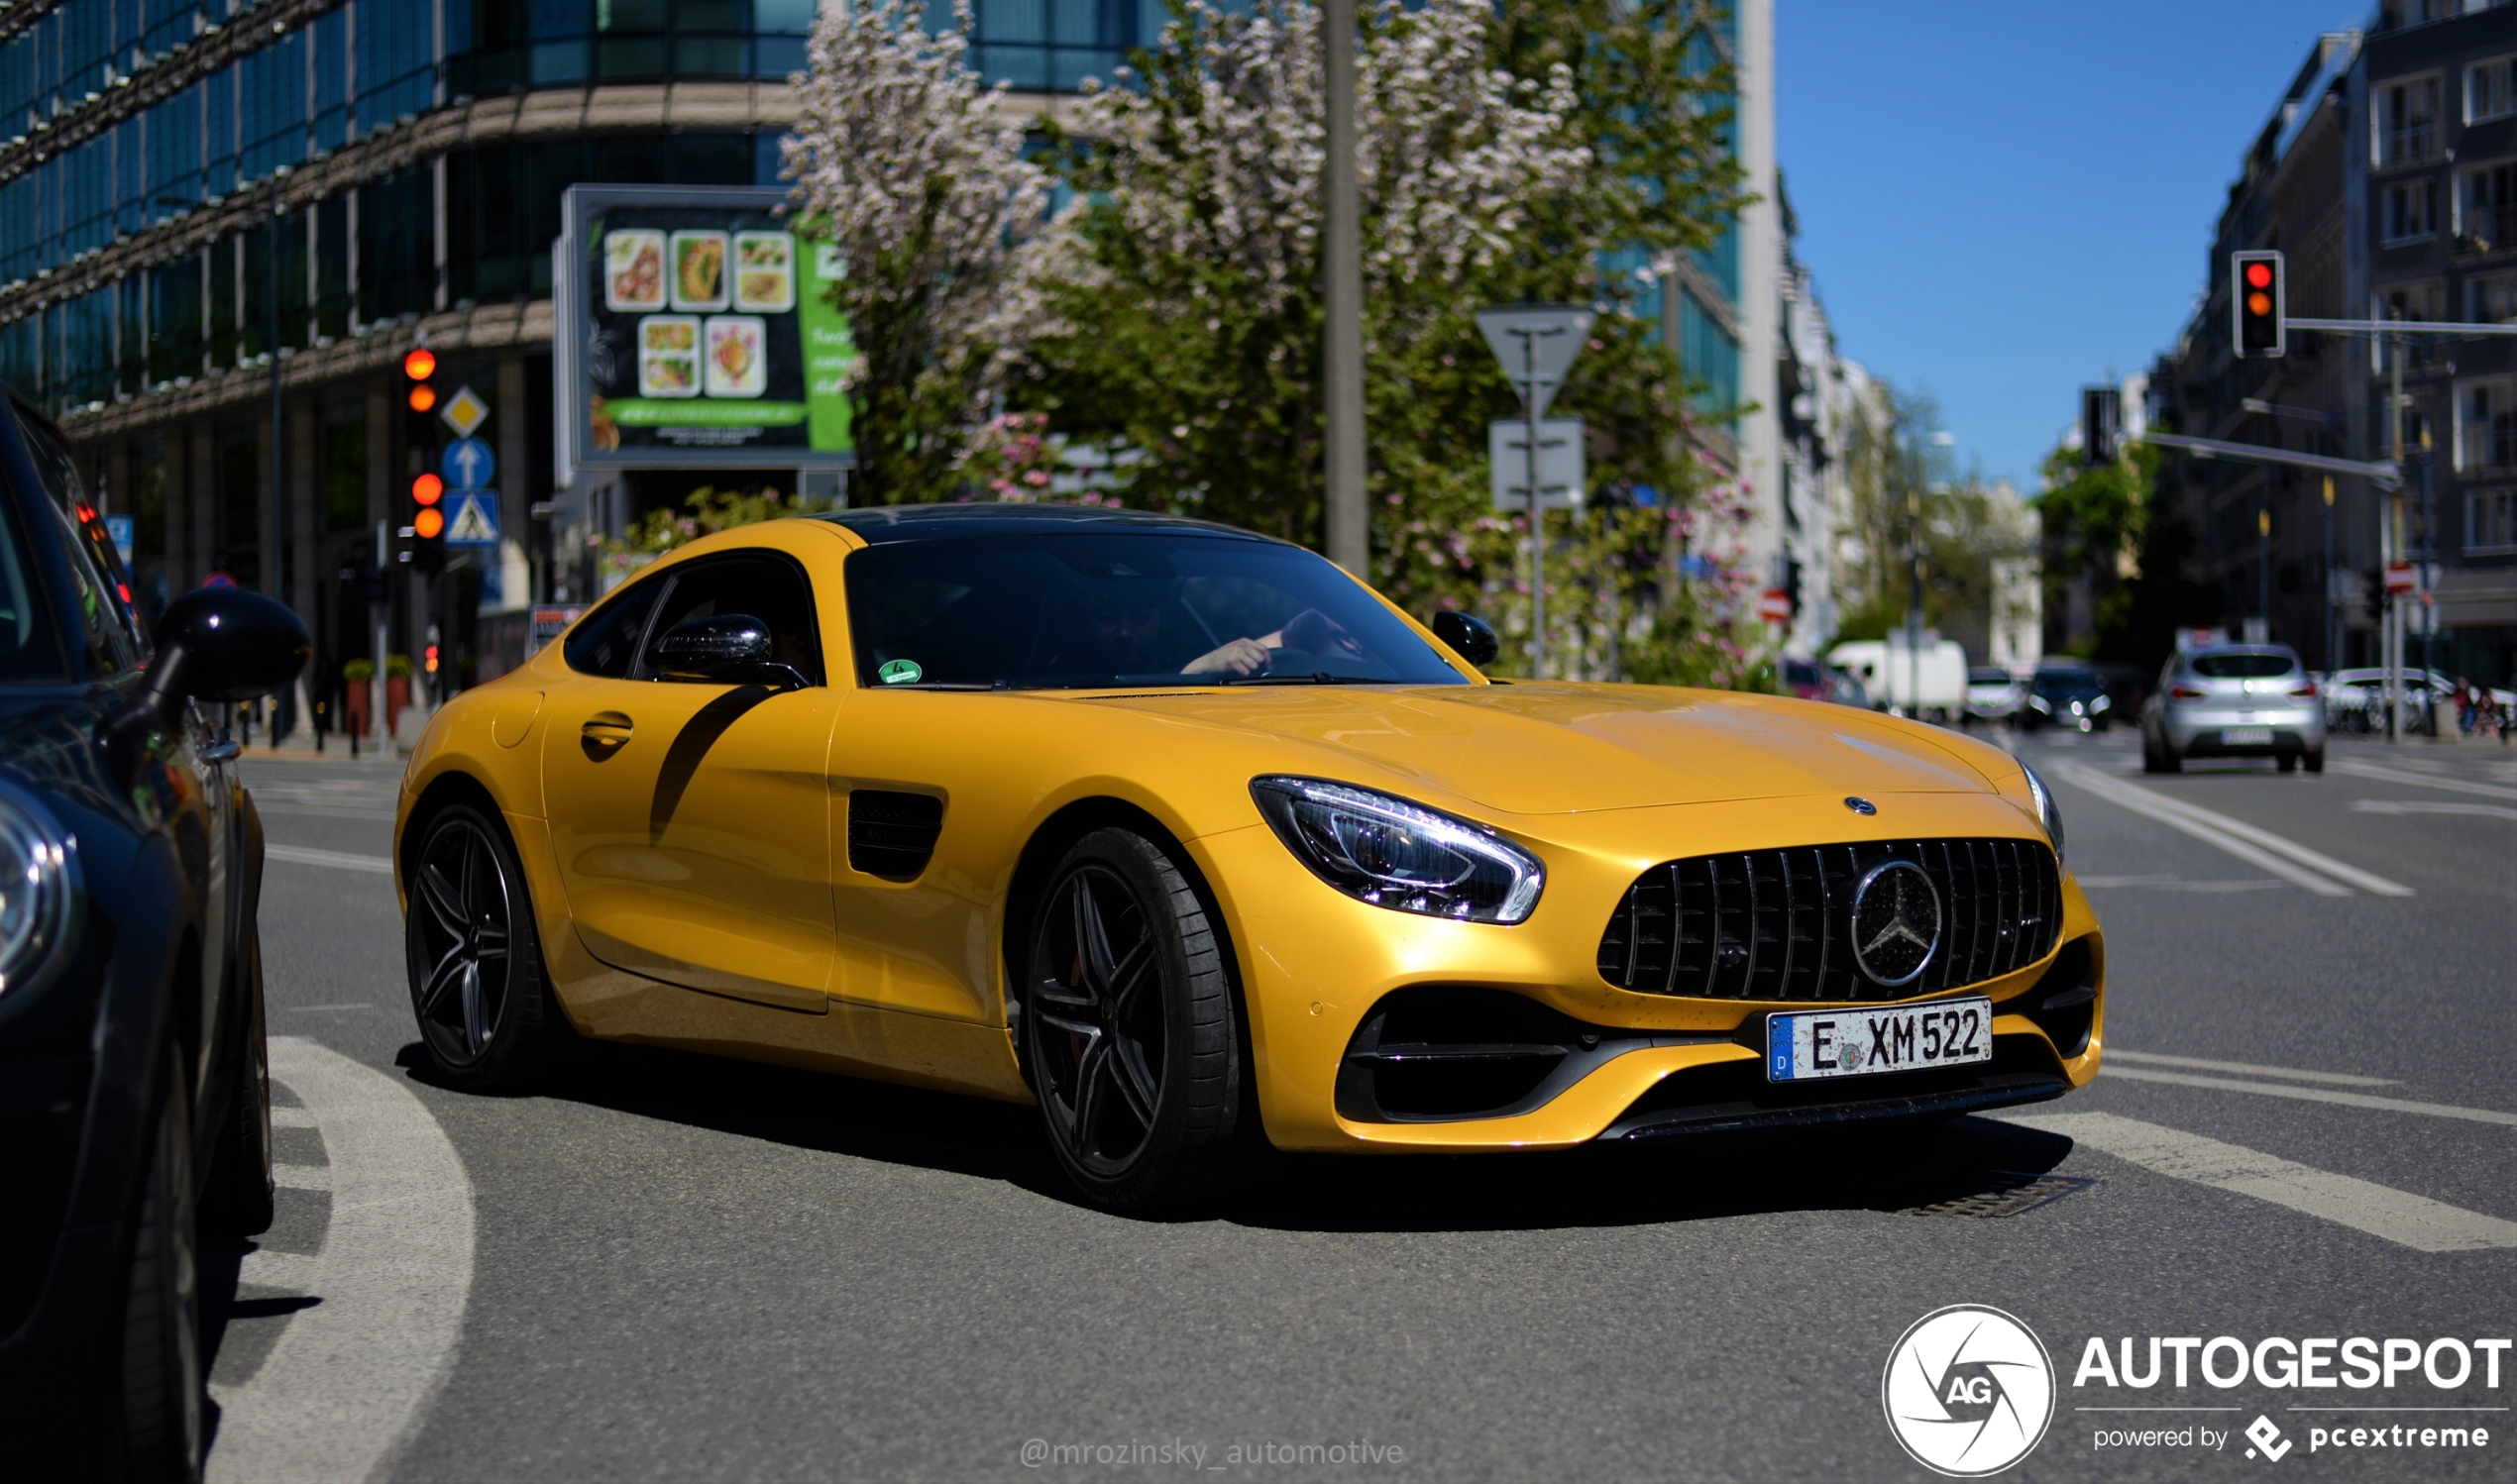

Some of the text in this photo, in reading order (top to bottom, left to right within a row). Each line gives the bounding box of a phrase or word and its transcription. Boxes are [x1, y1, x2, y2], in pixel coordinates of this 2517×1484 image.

[893, 662, 905, 673] 4
[1812, 1008, 1980, 1070] E XM 522
[1777, 1056, 1787, 1070] D
